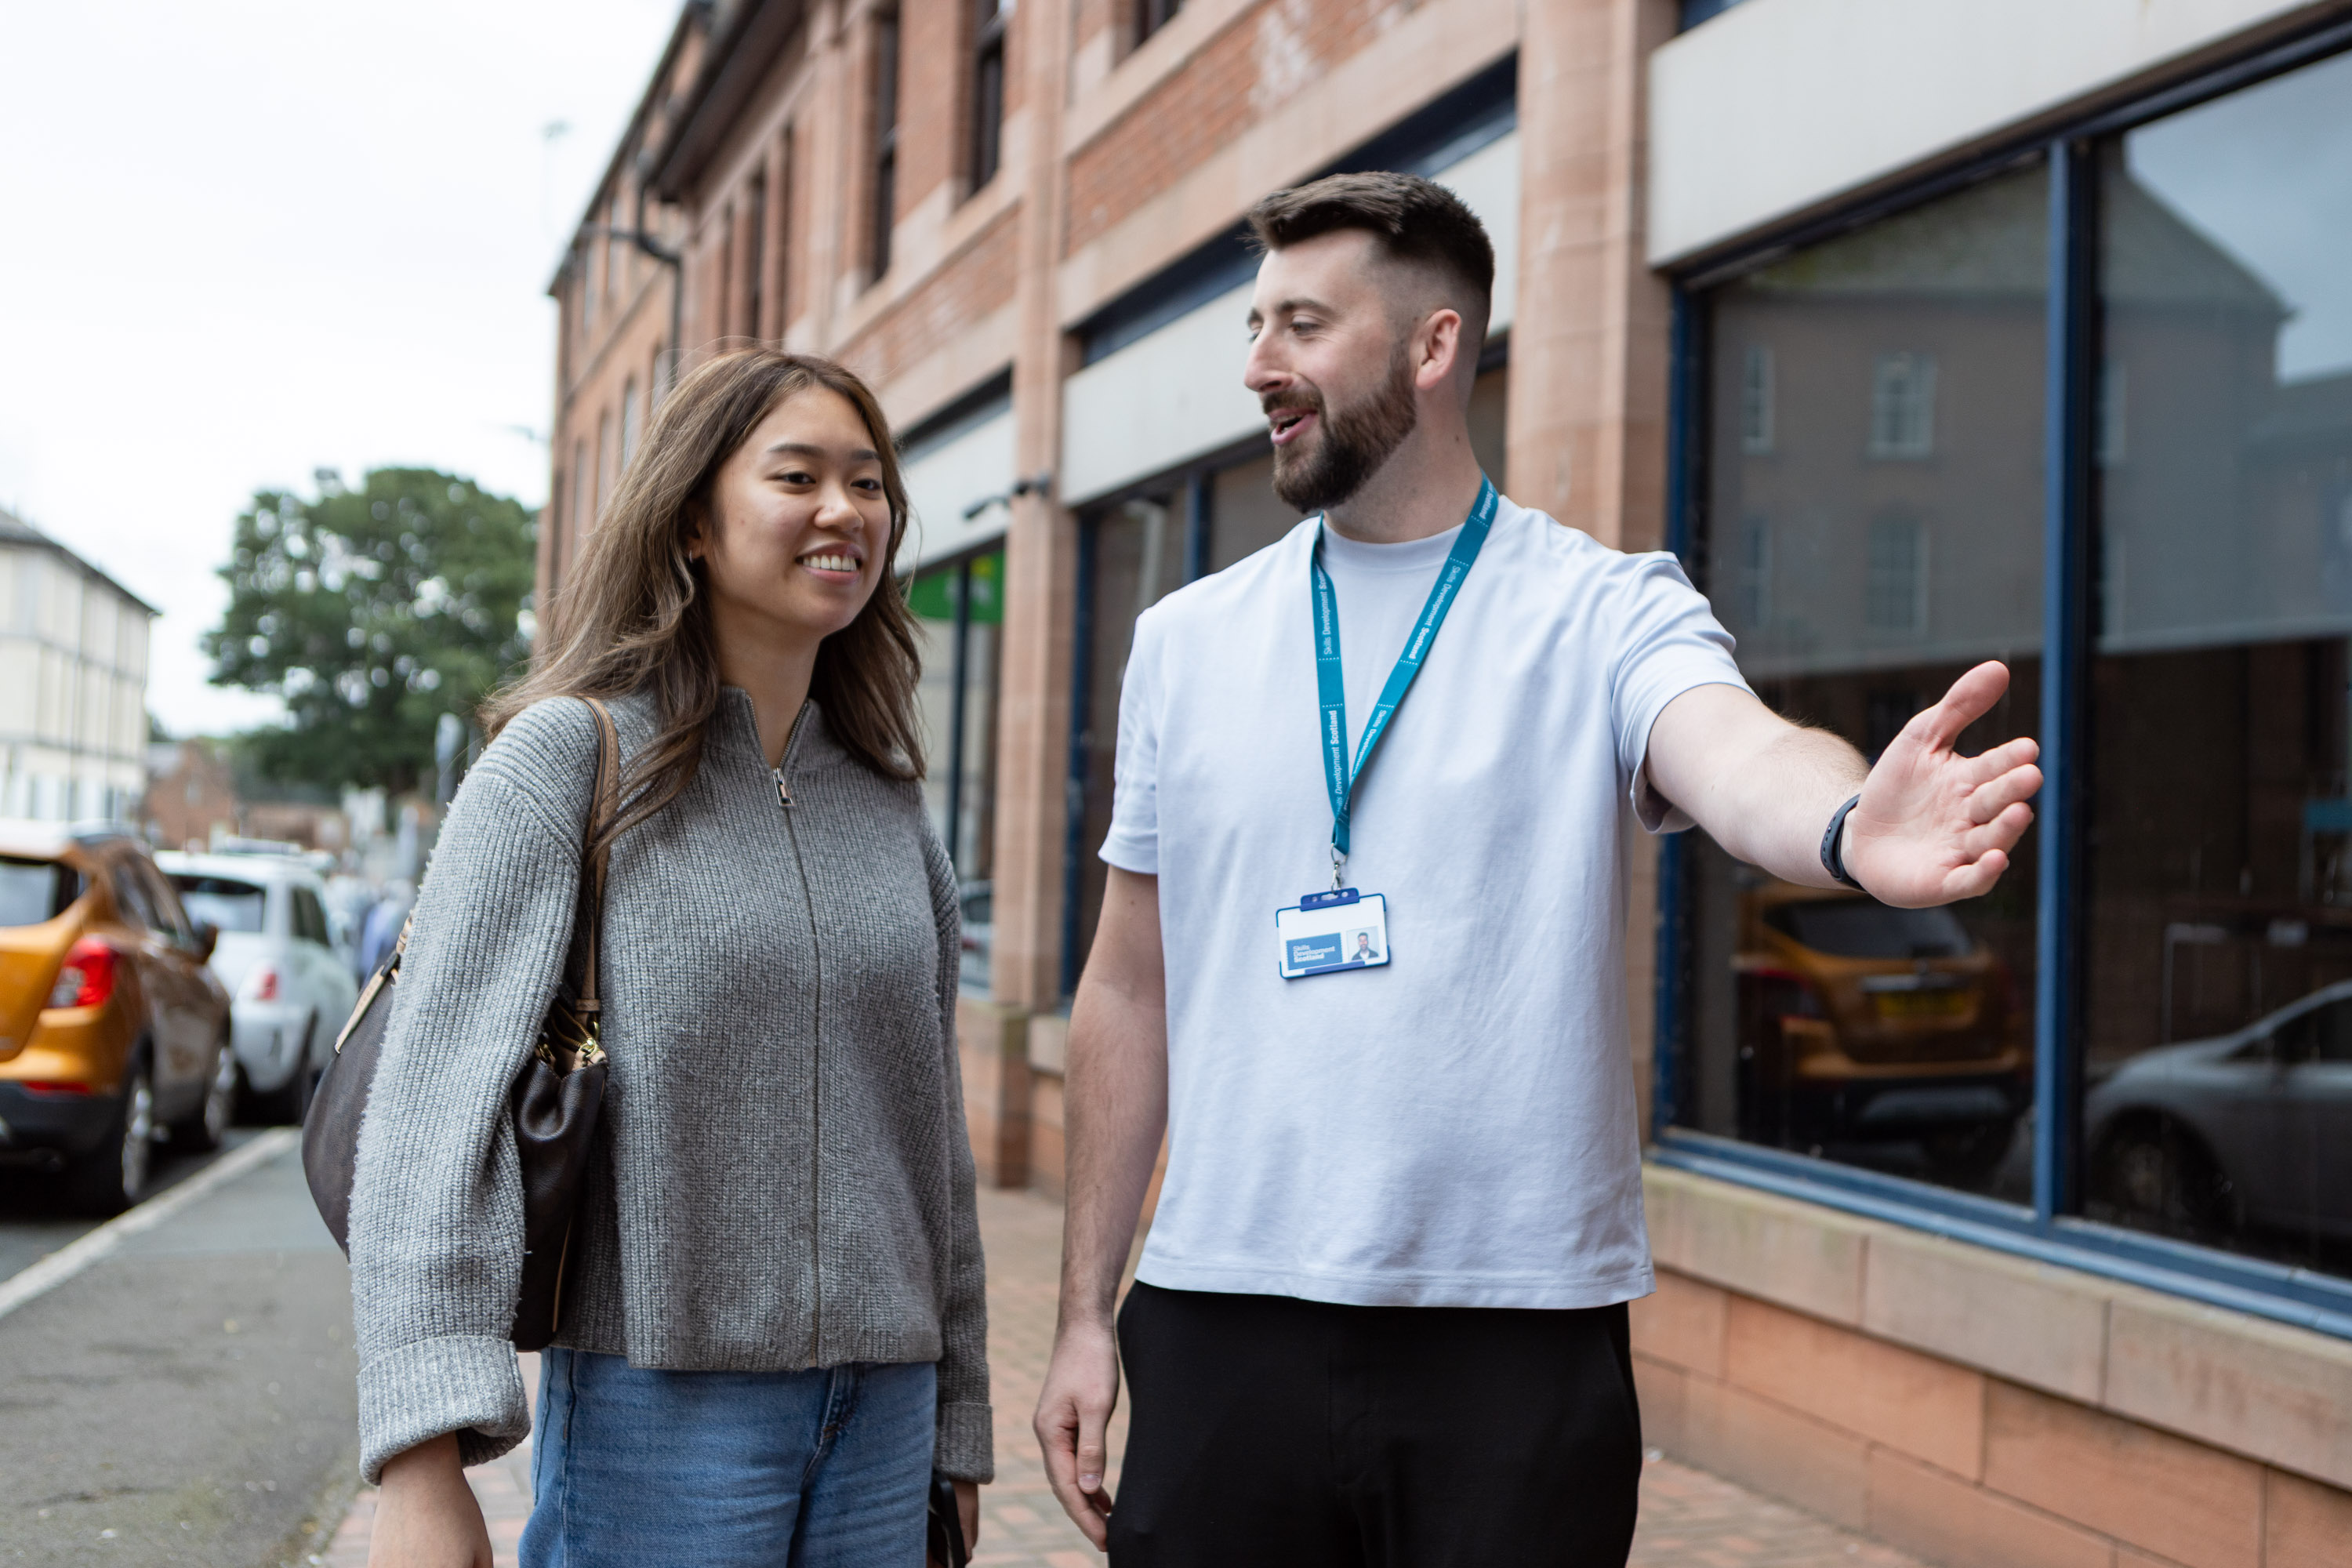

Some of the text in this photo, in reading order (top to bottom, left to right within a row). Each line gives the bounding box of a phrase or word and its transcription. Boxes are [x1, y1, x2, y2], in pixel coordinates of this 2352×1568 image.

[1320, 591, 1331, 635] Development
[1409, 565, 1461, 659] Skills Development Scotland
[1323, 637, 1333, 655] Skills
[1328, 710, 1340, 745] Scotland
[1373, 710, 1387, 728] Skills
[1331, 746, 1343, 794] Development
[1294, 946, 1335, 957] Development
[1294, 953, 1325, 963] Scotland
